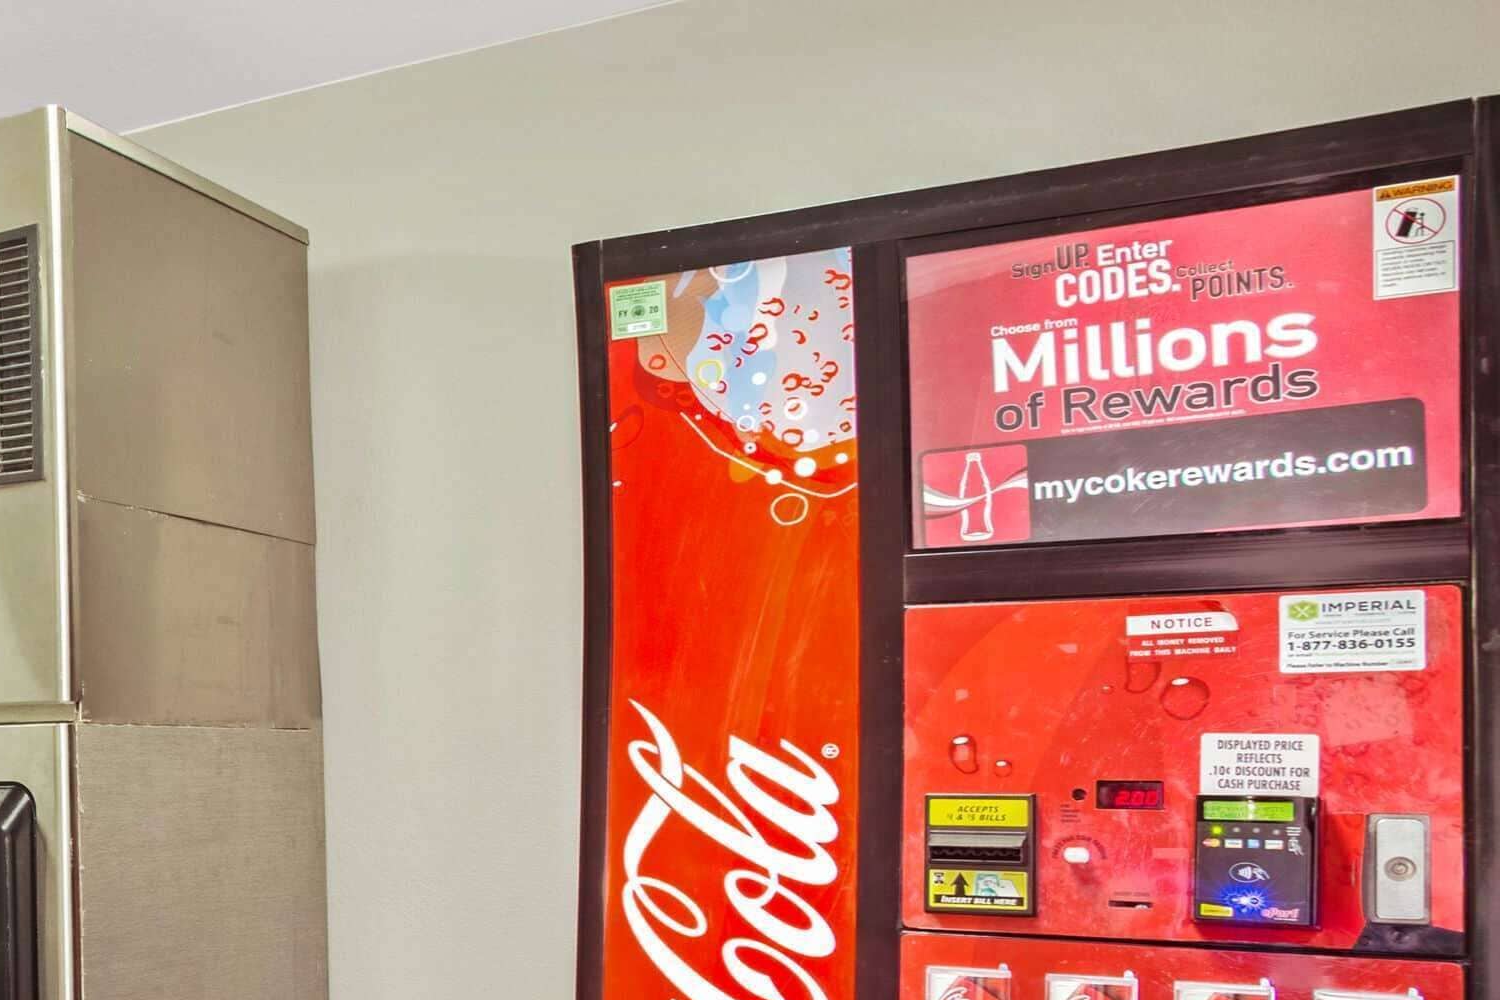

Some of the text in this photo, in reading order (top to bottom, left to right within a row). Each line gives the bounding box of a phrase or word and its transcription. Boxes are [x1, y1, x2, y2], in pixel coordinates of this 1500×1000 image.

[1096, 240, 1173, 266] Enter
[1055, 259, 1182, 307] CODES.
[1191, 266, 1294, 301] POINTS.
[990, 317, 1078, 338] Choose from
[991, 312, 1318, 392] Millions
[994, 391, 1046, 432] of
[1061, 361, 1319, 425] Rewards
[1033, 444, 1414, 505] mycokerewards.com
[1321, 600, 1417, 613] IMPERIAL
[1150, 617, 1213, 630] NOTICE
[1309, 630, 1350, 639] Service
[1352, 629, 1390, 638] Please
[1392, 627, 1416, 636] Call
[1287, 638, 1416, 651] 1-877-836-0155
[1217, 739, 1304, 751] DISPLAYED PRICE
[1236, 753, 1283, 764] REFLECTS
[1235, 766, 1286, 777] DISCOUNT
[1289, 767, 1311, 778] FOR
[1217, 779, 1301, 791] CASH PURCHASE
[979, 814, 1007, 822] BILLS
[940, 895, 972, 904] INSERT
